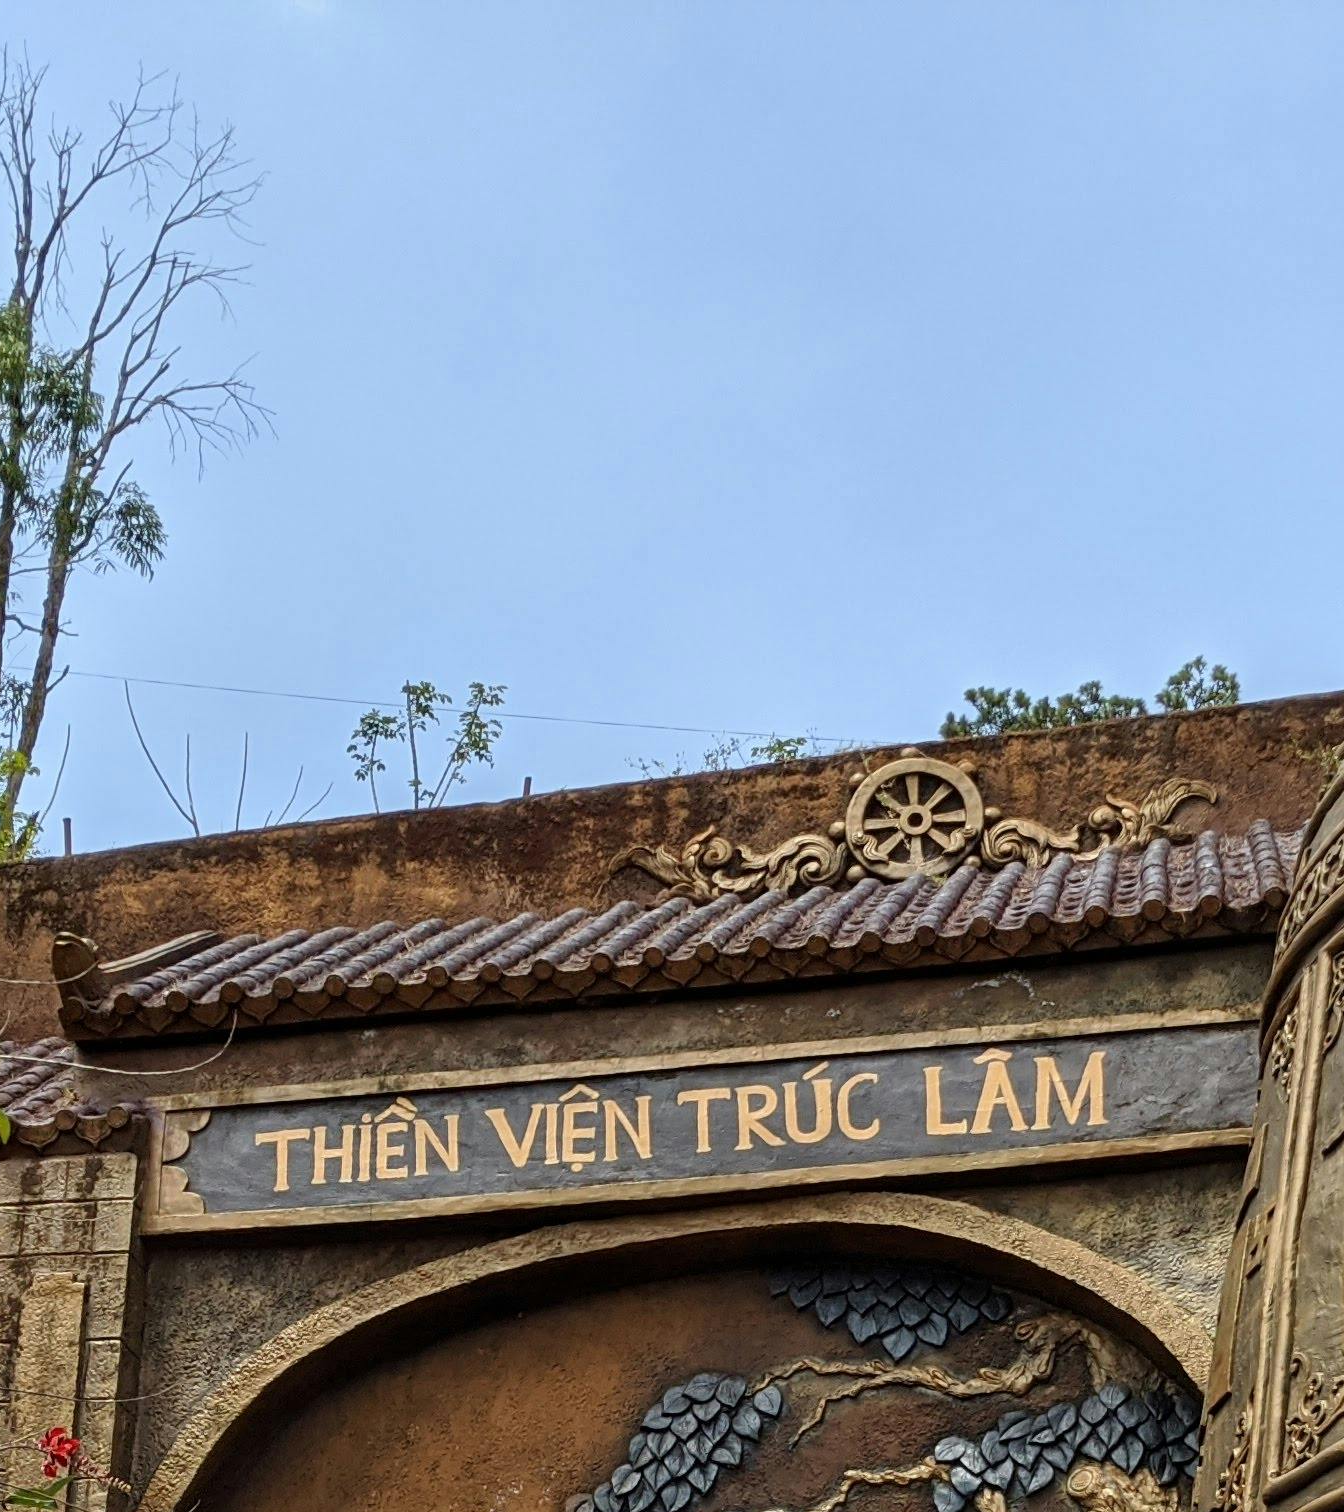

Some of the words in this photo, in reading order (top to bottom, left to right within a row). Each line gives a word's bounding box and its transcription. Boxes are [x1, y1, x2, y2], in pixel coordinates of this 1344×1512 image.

[484, 1083, 653, 1173] VIỆN
[677, 1061, 881, 1154] TRÚC
[922, 1048, 1109, 1135] LÂM
